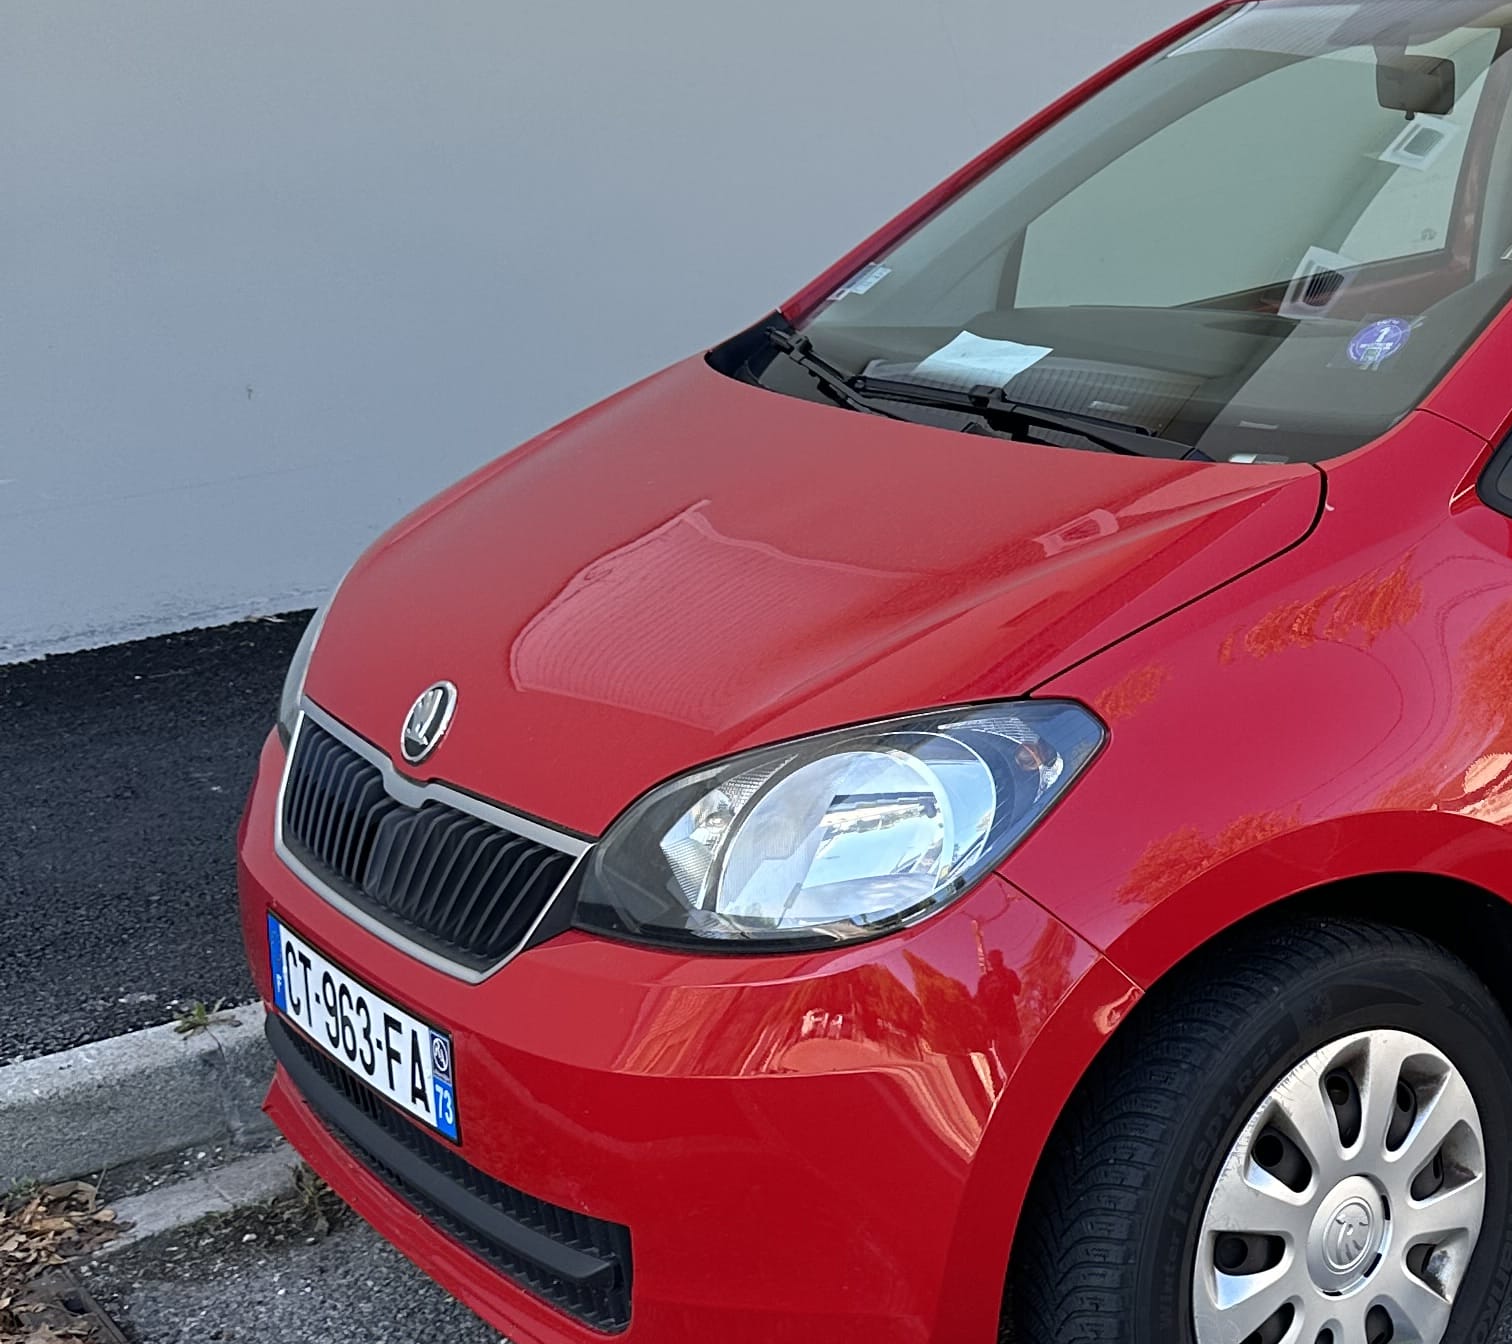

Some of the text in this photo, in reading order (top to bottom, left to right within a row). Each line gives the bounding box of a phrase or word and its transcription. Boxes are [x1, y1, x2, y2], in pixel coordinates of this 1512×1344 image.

[275, 973, 282, 993] F
[285, 940, 431, 1113] CT-963-FA
[435, 1084, 454, 1125] 73
